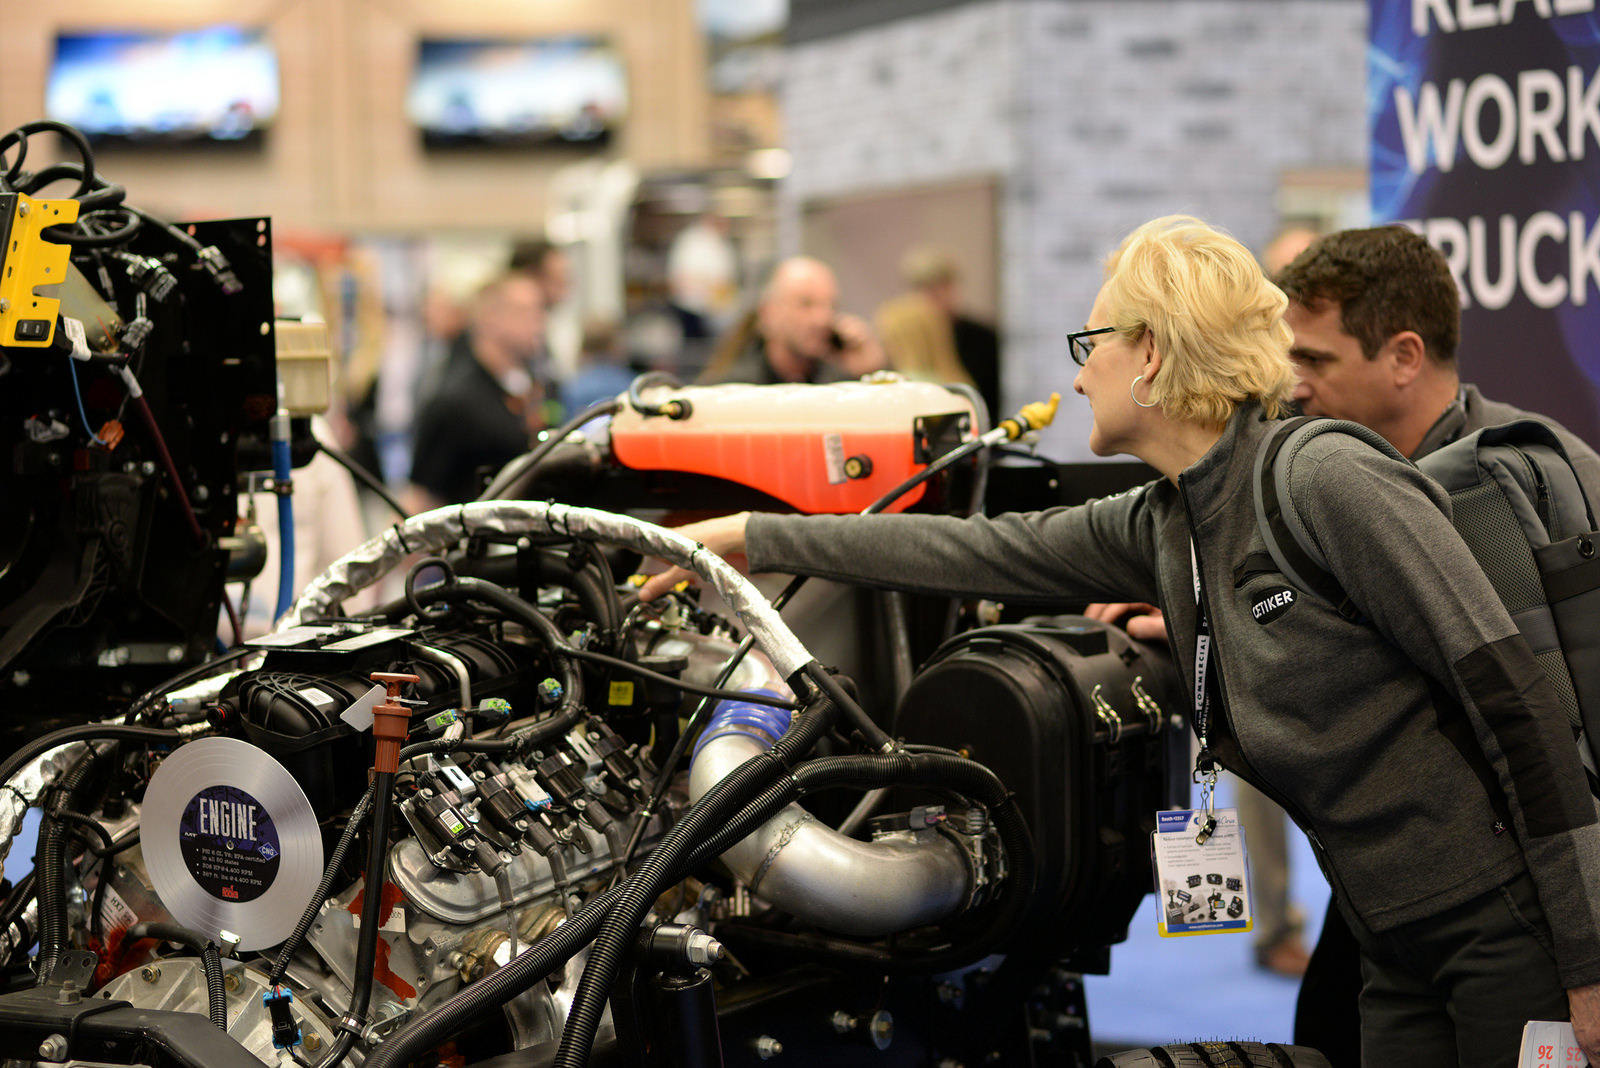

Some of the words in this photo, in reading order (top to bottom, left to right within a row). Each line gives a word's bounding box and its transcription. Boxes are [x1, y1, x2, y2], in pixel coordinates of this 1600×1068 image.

[1394, 65, 1600, 174] WORK
[1391, 211, 1600, 310] RUCK
[1197, 638, 1207, 707] COMMERCIAL
[200, 798, 257, 841] ENGINE
[261, 847, 274, 856] CNG
[1538, 1045, 1554, 1060] 26
[1566, 1047, 1582, 1061] 25
